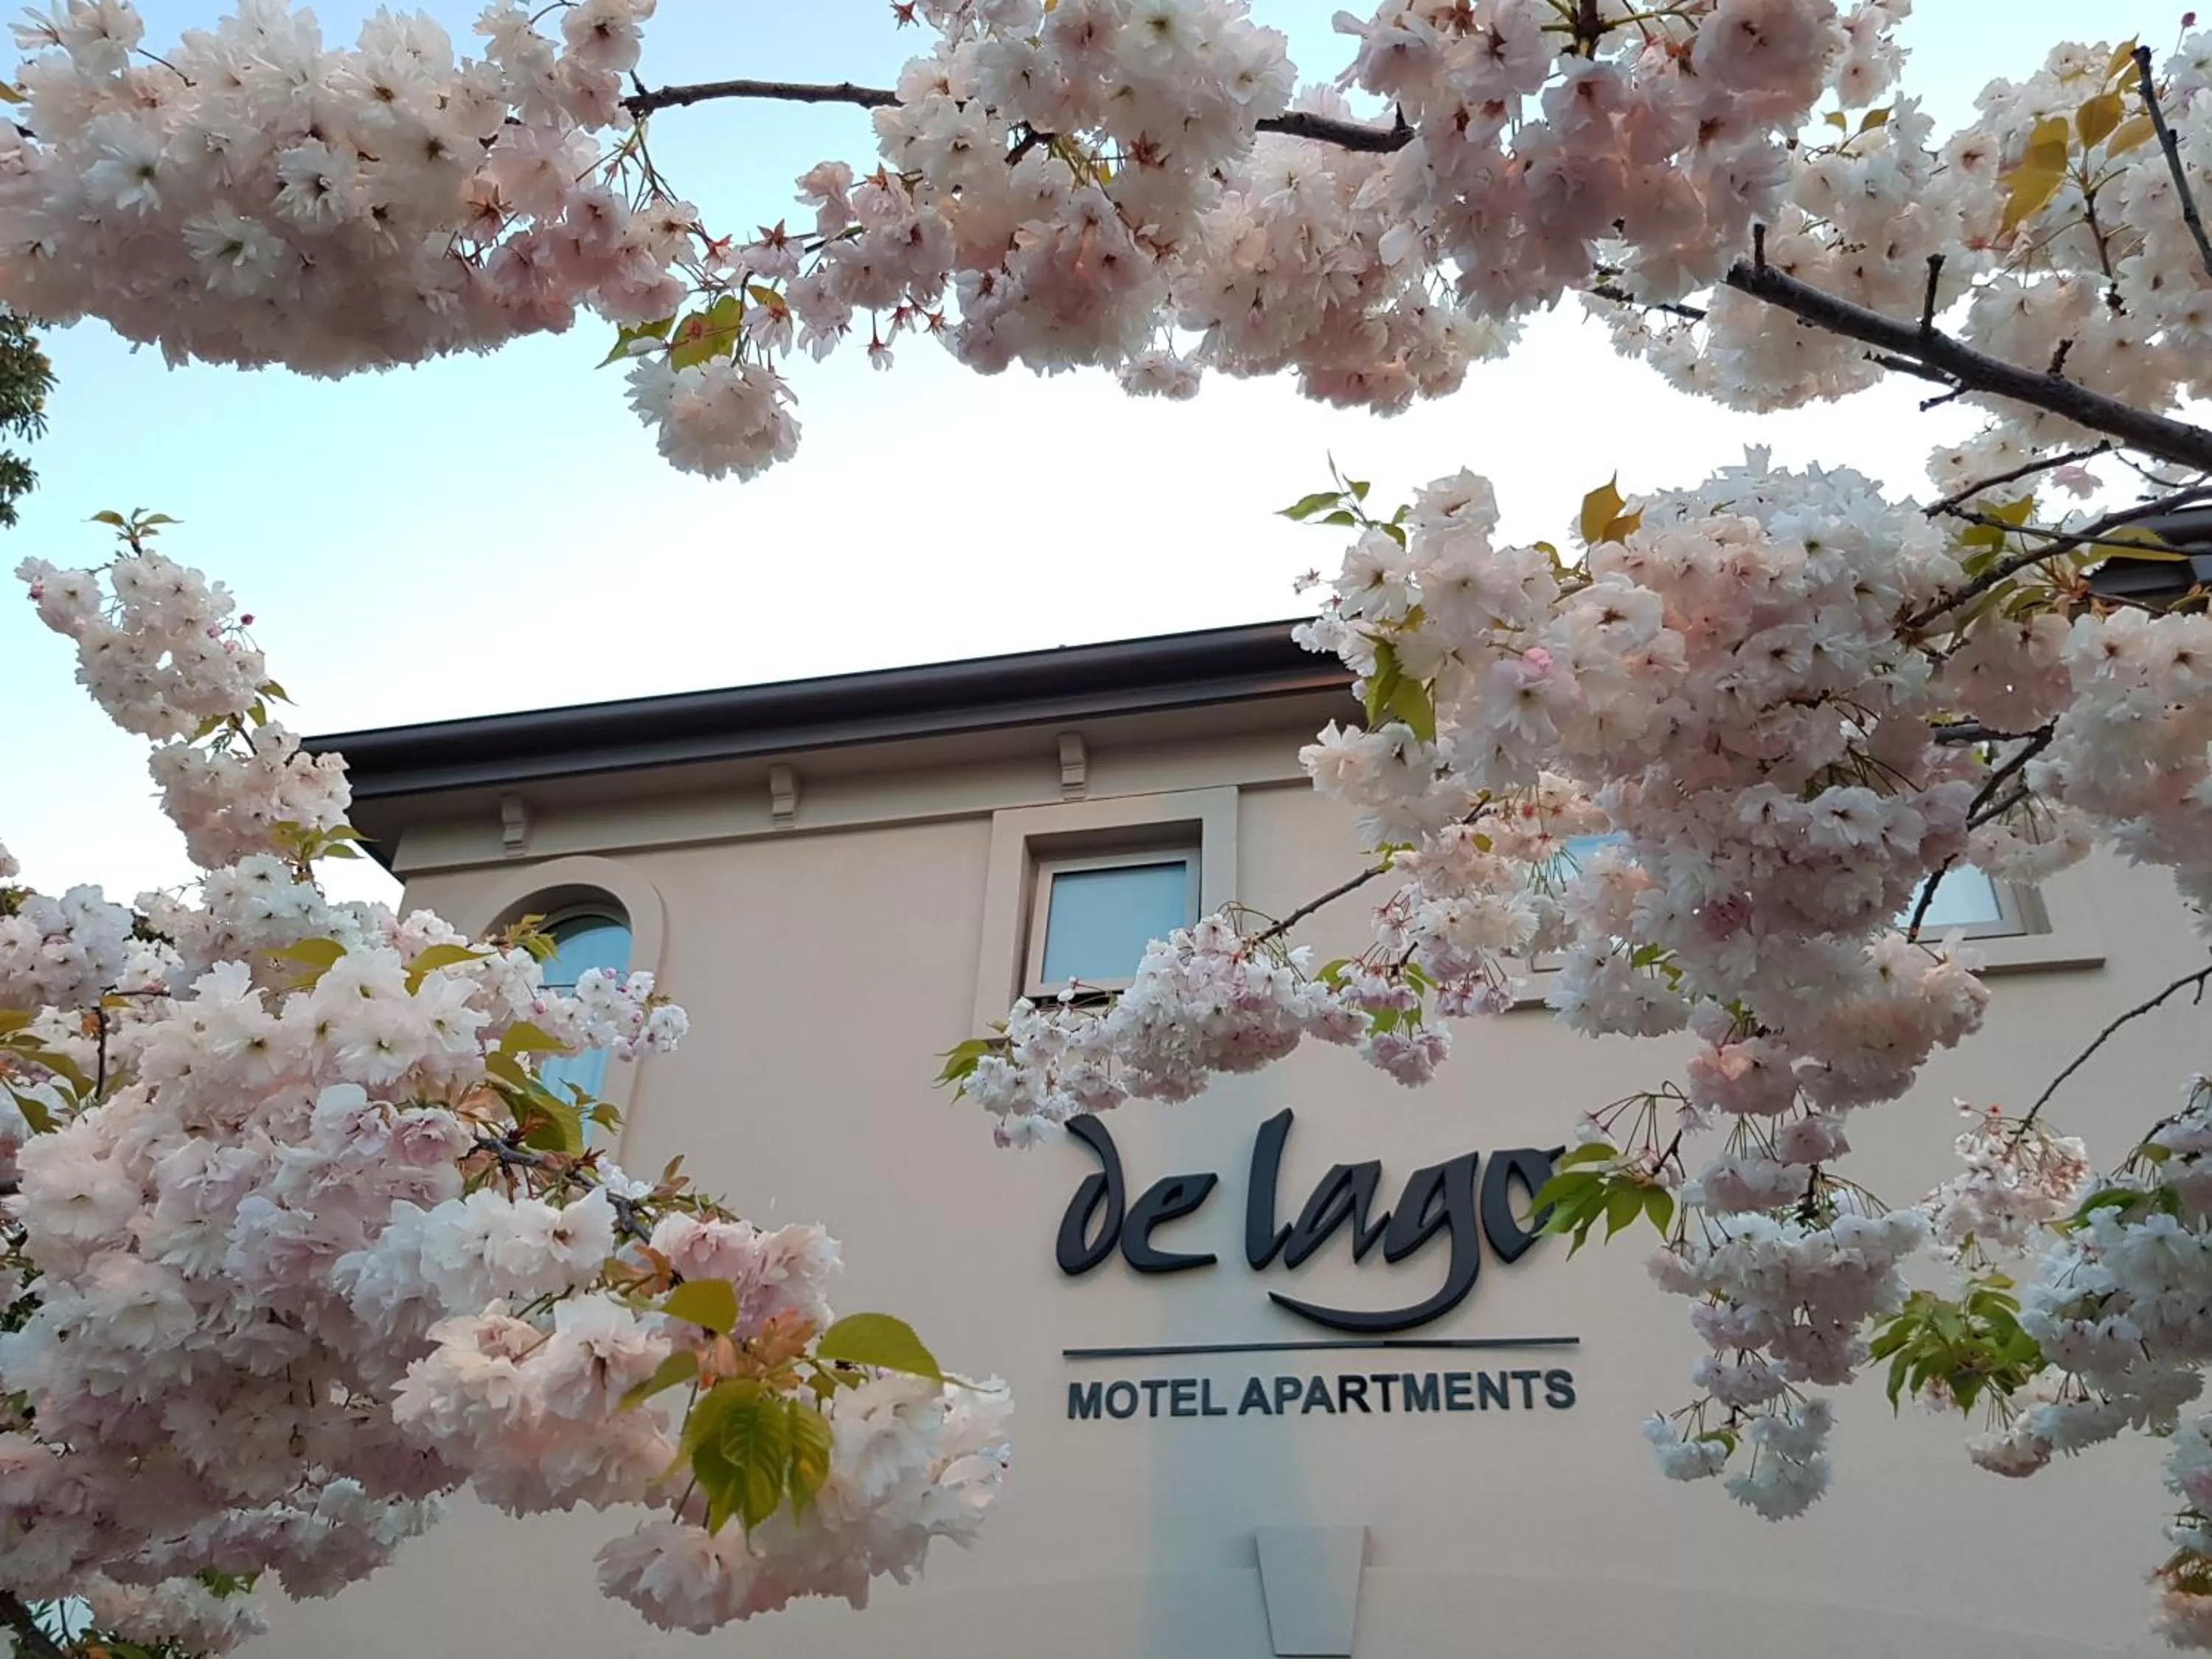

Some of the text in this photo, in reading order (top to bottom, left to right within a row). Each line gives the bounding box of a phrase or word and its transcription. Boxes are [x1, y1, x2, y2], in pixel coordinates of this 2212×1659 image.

[1057, 1107, 1567, 1332] de lago
[1067, 1368, 1576, 1420] MOTEL APARTMENTS
